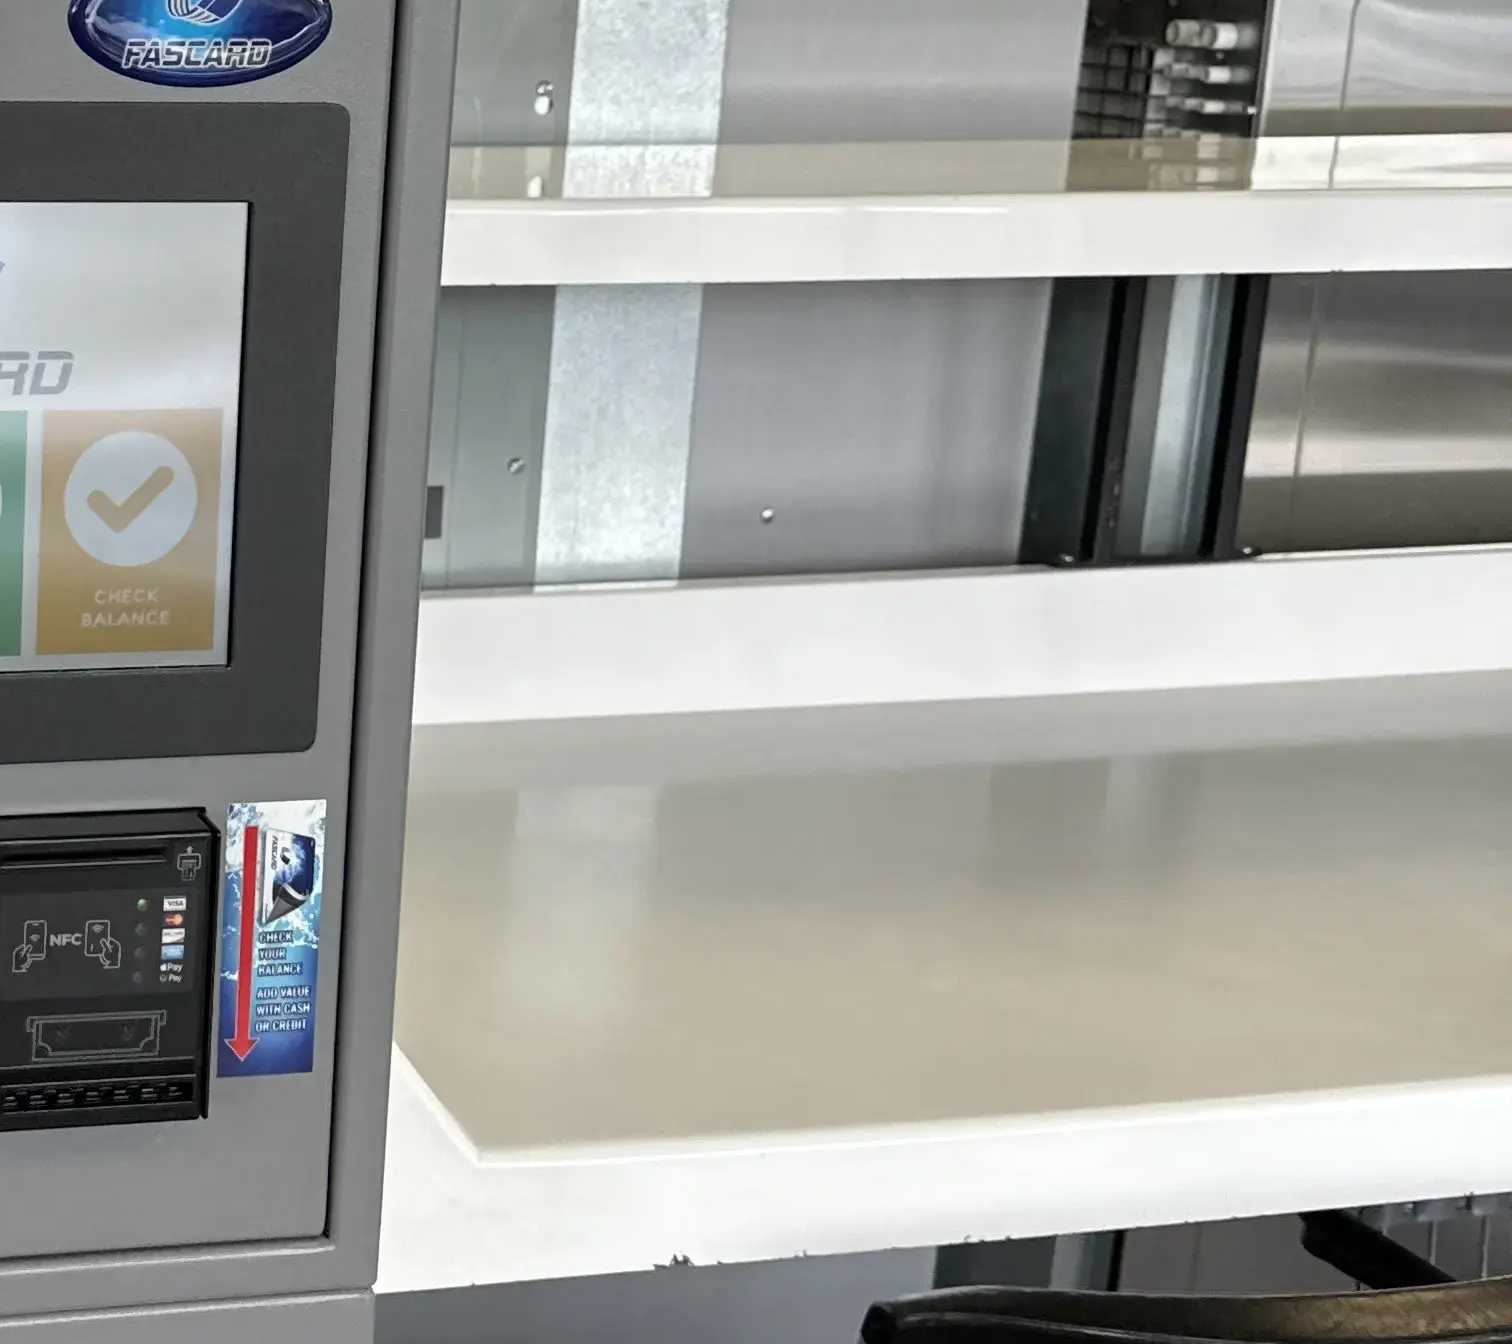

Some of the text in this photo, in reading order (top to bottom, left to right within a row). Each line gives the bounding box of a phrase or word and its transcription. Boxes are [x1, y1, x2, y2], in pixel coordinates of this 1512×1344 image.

[122, 38, 272, 68] FASCARD
[94, 588, 159, 605] CHECK
[81, 610, 170, 628] BALANCE
[49, 933, 83, 947] NFC
[258, 931, 293, 944] CHECK
[258, 948, 287, 960] YOUR
[257, 962, 304, 976] BALANCE
[256, 985, 311, 999] ADD VALUE
[255, 1002, 311, 1016] WITH CASH
[255, 1018, 308, 1032] OR CREDIT
